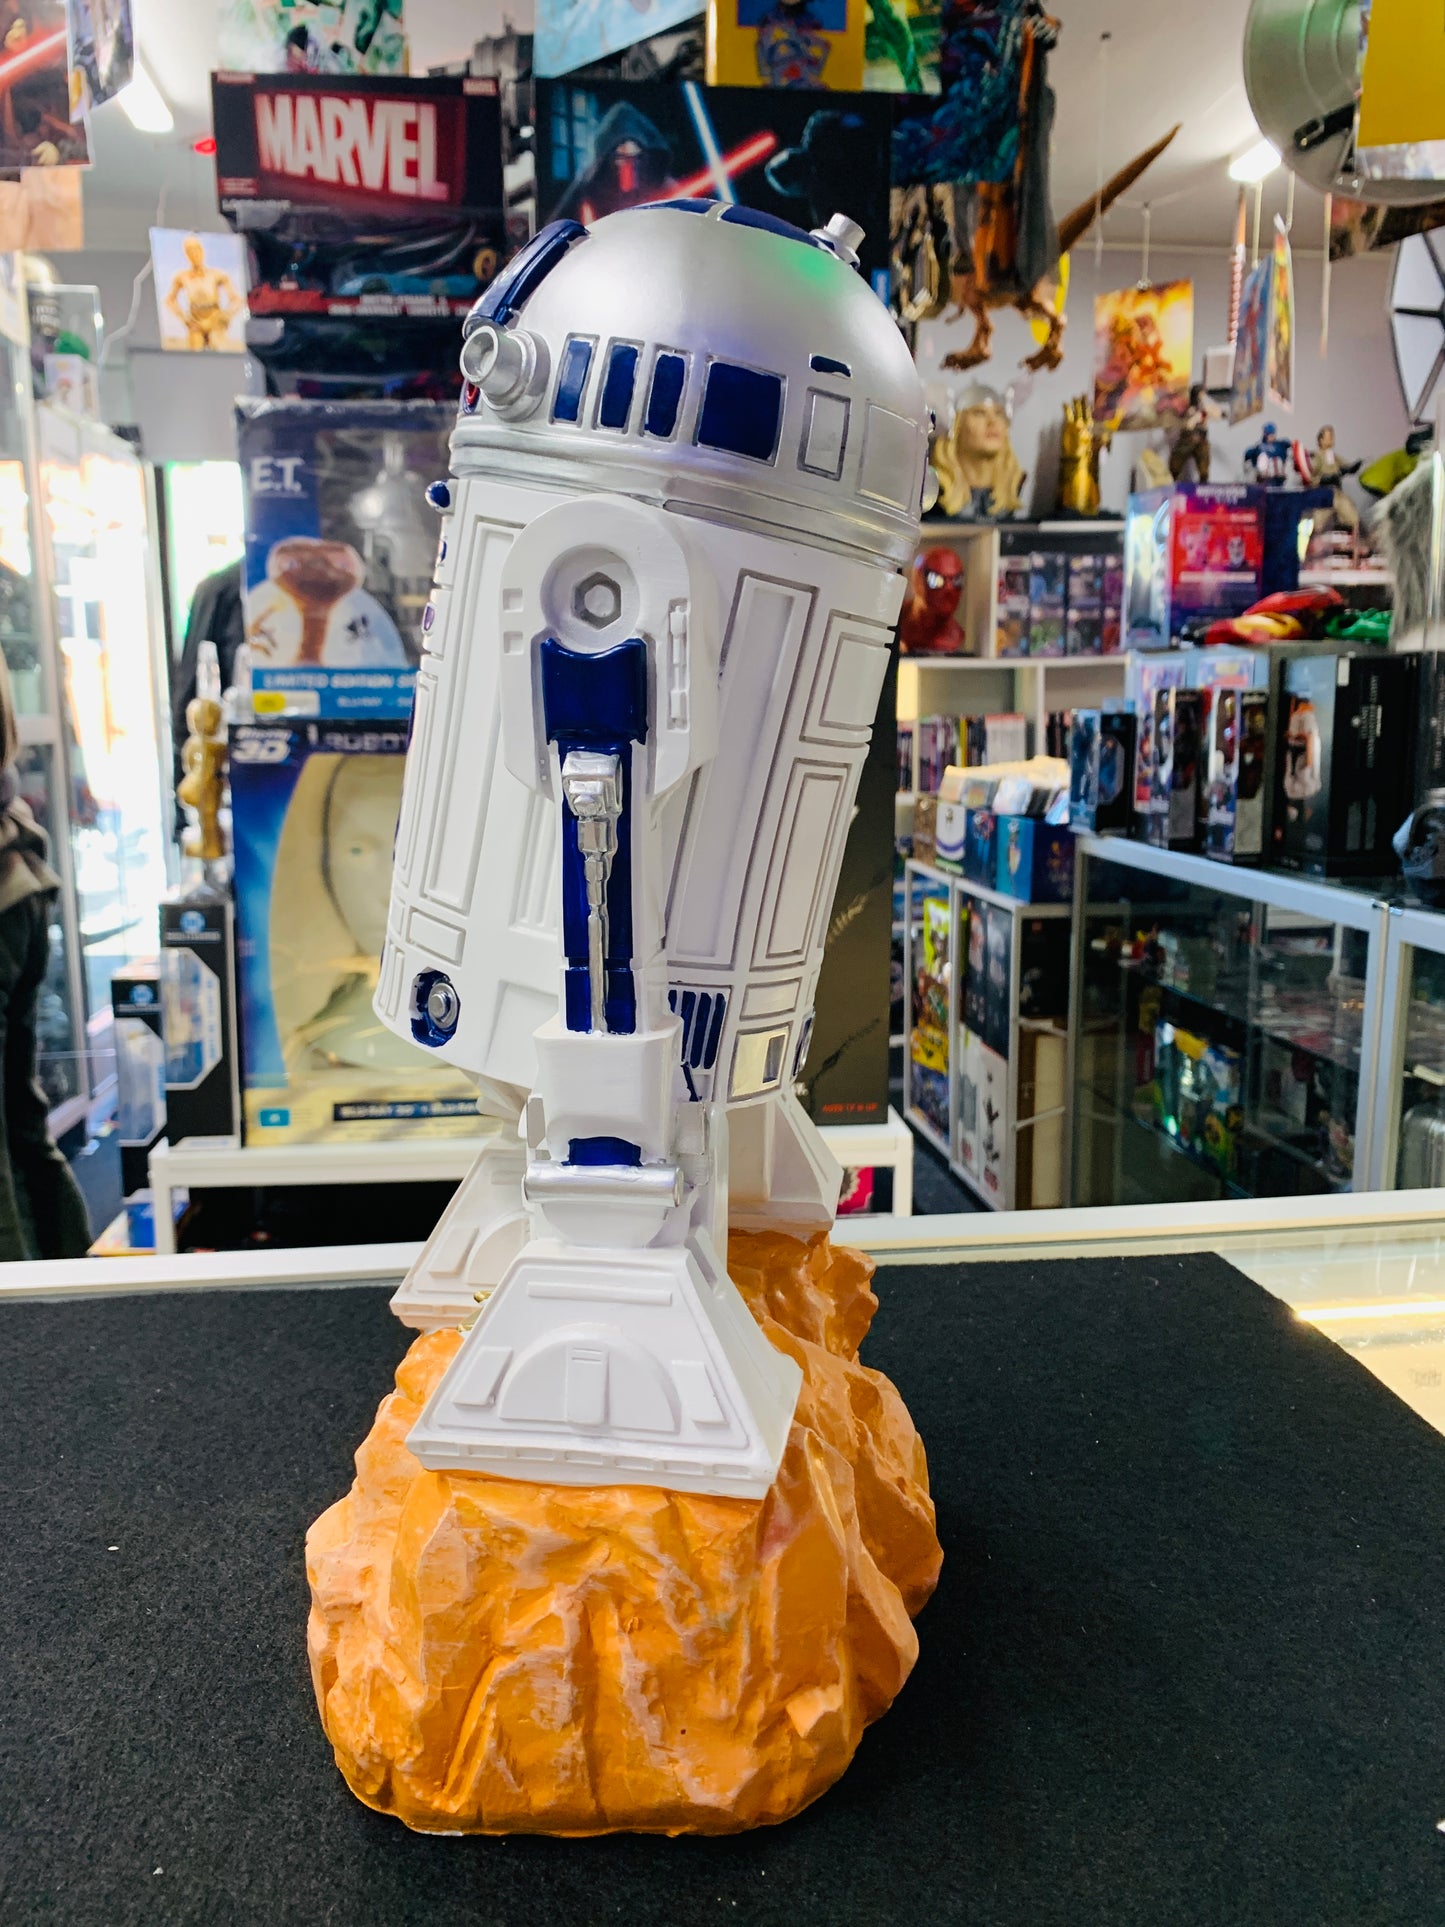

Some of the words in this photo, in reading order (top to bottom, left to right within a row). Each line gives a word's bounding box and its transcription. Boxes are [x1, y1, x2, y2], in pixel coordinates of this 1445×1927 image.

[254, 93, 448, 200] MARVEL
[251, 455, 306, 492] E.T.
[231, 737, 291, 764] 3D
